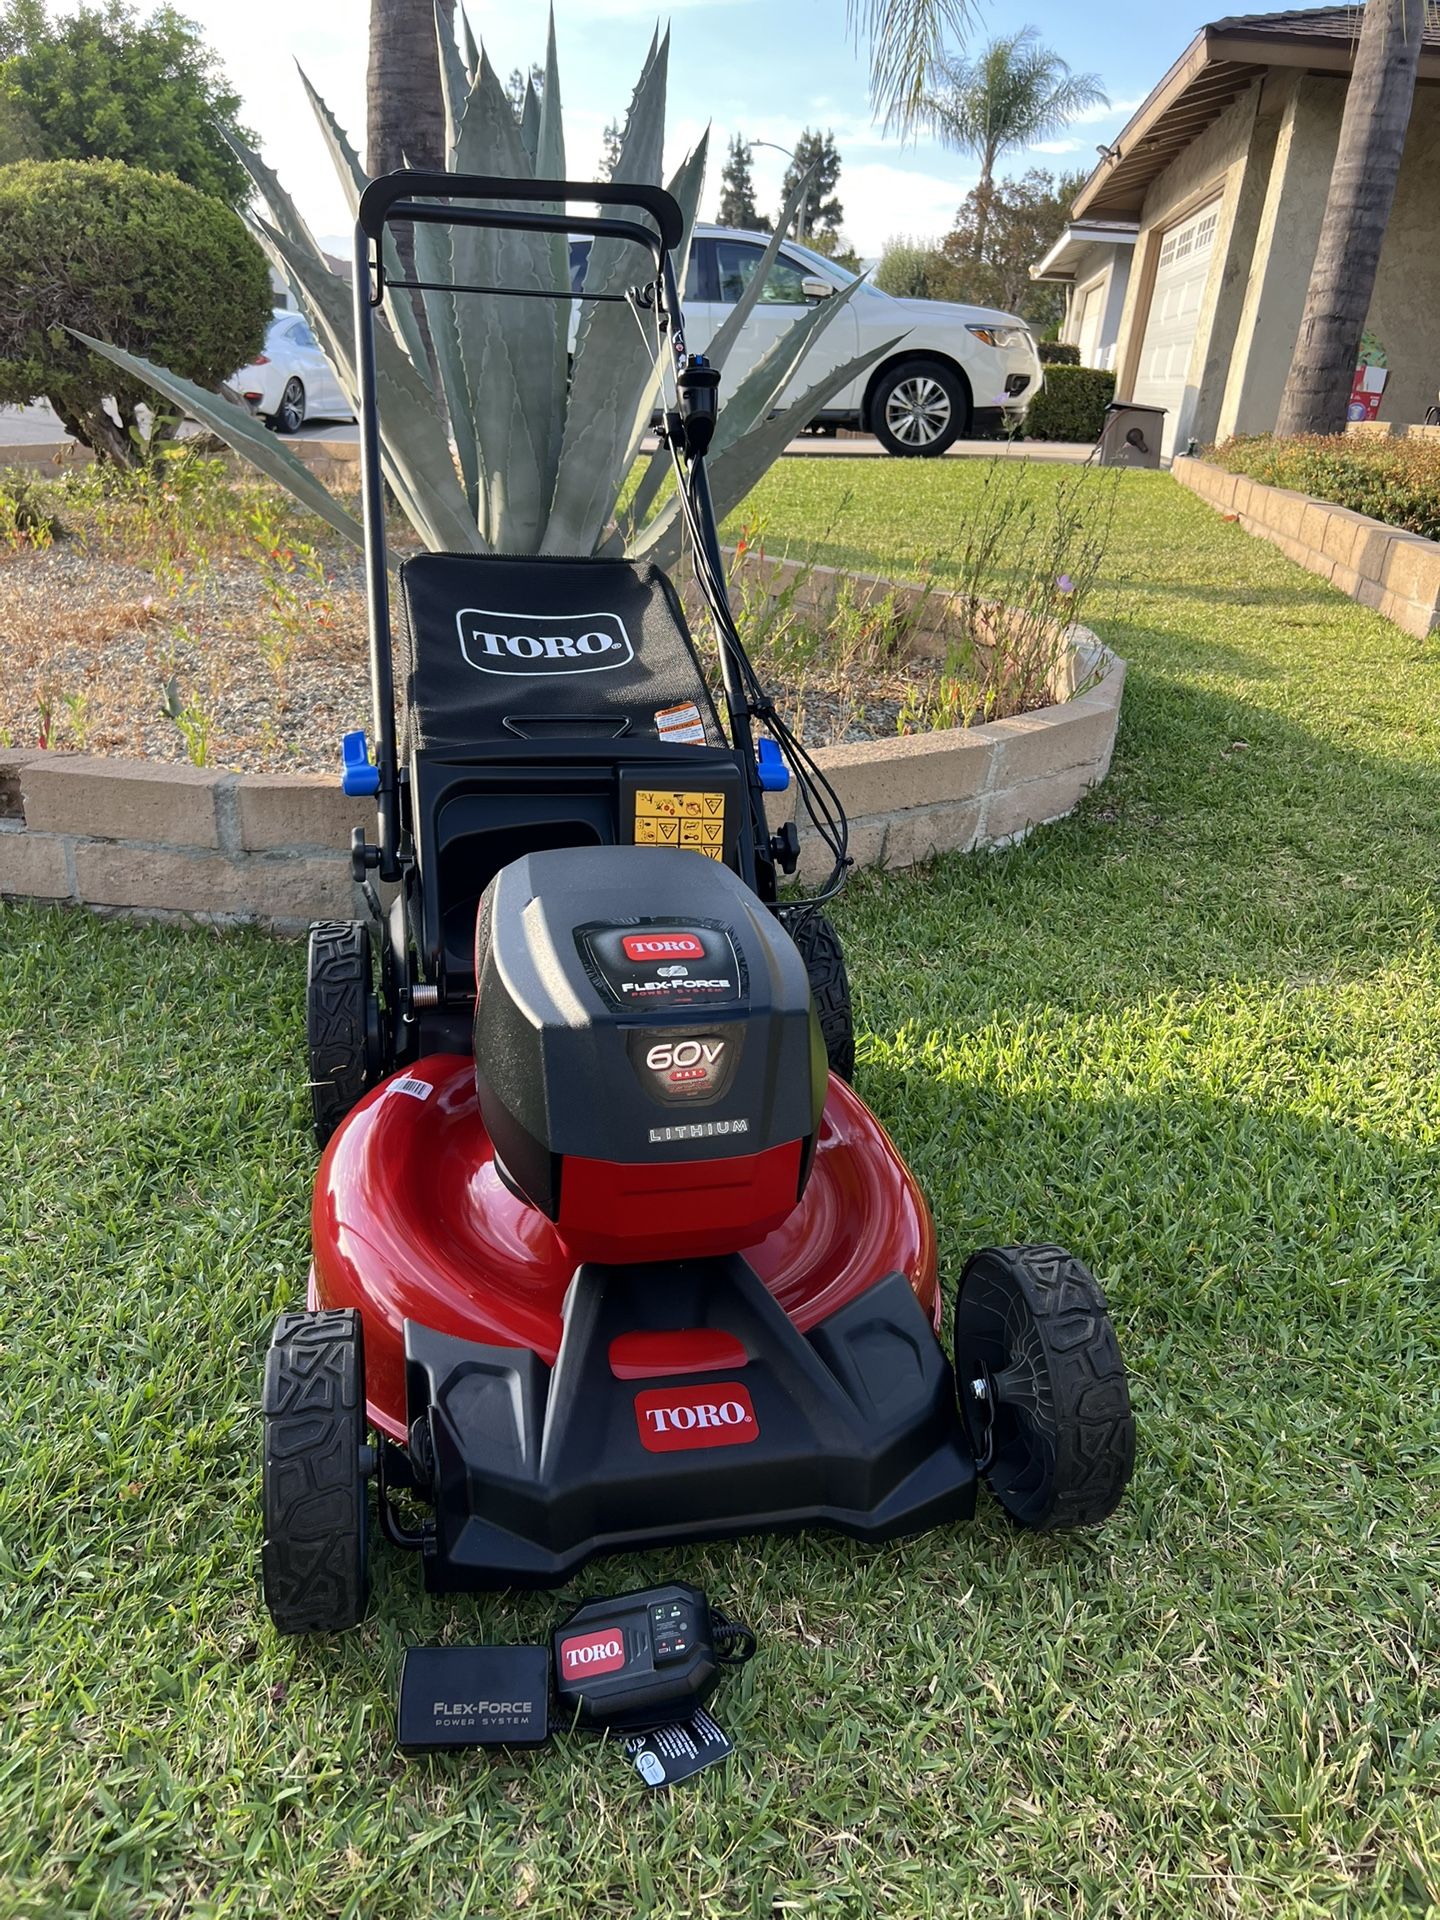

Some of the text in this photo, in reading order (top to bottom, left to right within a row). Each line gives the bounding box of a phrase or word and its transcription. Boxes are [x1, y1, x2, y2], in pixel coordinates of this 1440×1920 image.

[472, 630, 613, 658] TORO
[630, 940, 696, 953] TORO
[621, 979, 731, 993] FLEX-FORCE
[631, 989, 670, 998] POWER
[649, 1119, 748, 1142] LITHIUM
[645, 1401, 746, 1432] TORO
[566, 1640, 620, 1667] TORO
[433, 1701, 532, 1716] FLEX-FORCE
[435, 1716, 529, 1727] POWER SYSTEM
